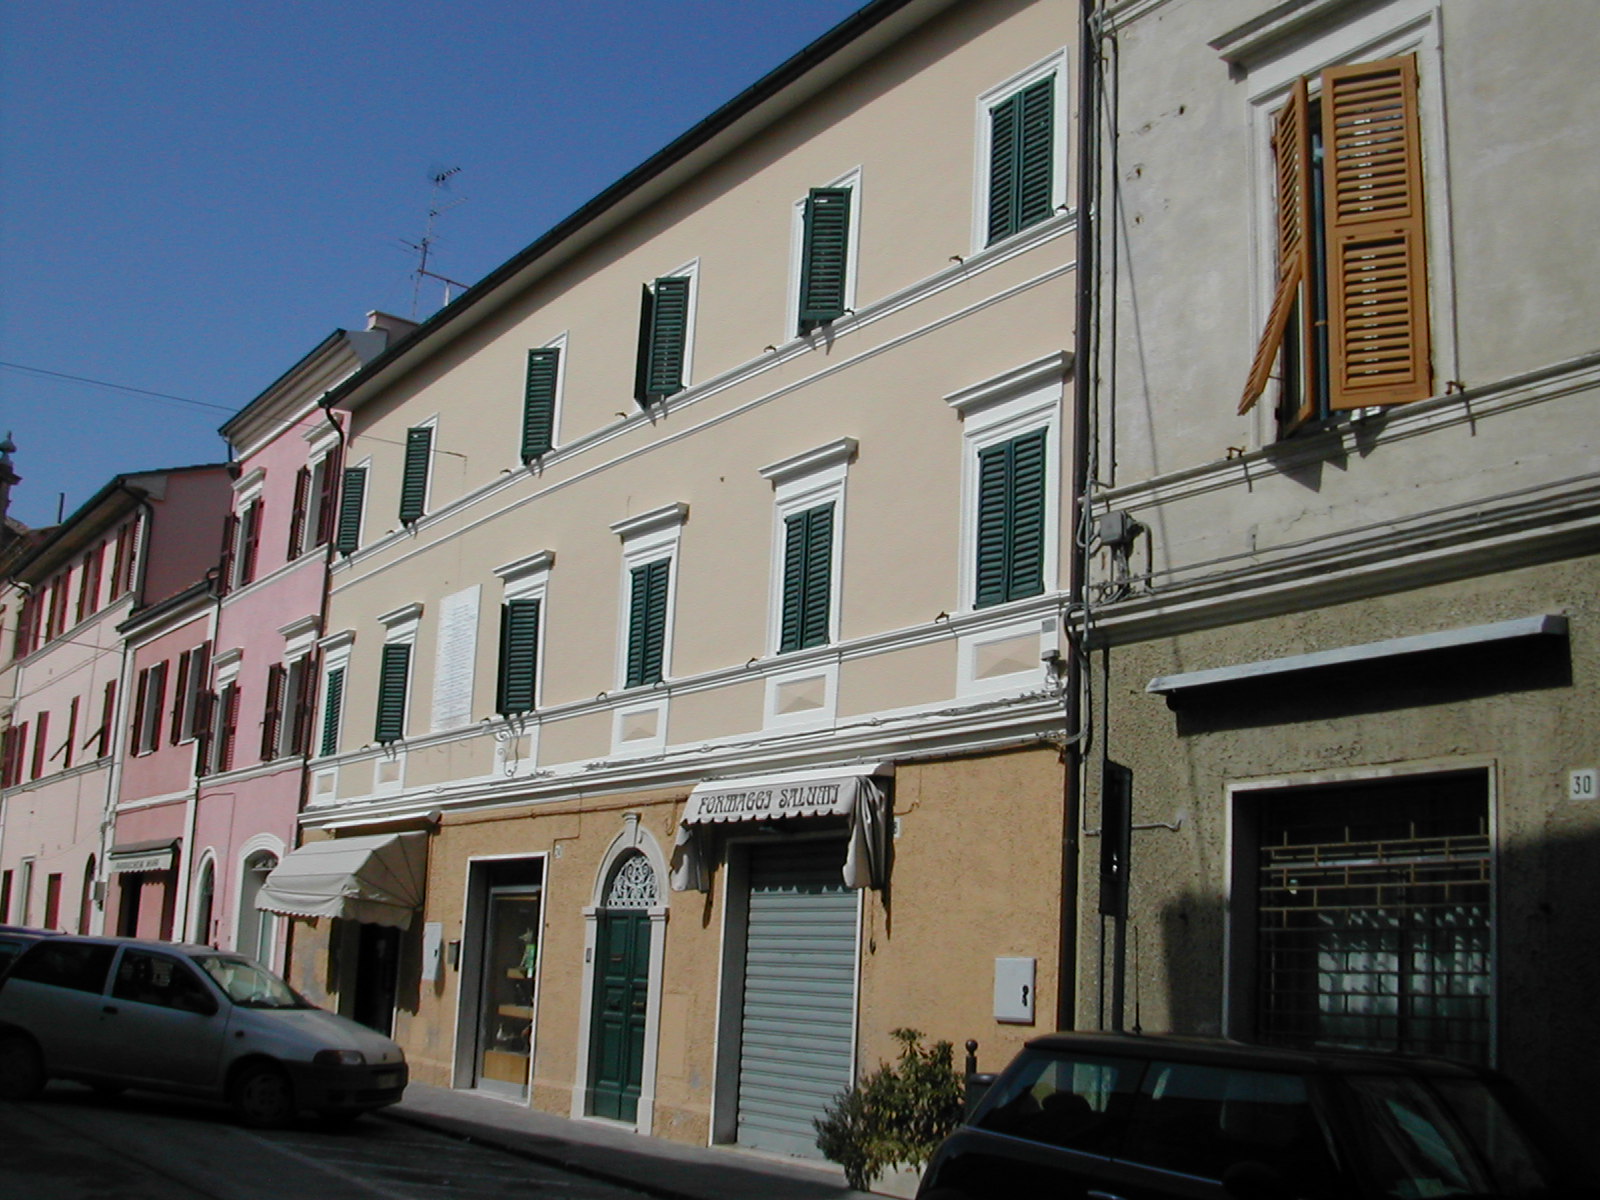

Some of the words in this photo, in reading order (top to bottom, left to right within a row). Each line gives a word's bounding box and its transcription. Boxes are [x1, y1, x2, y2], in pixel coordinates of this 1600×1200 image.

[1573, 775, 1591, 794] 30
[698, 791, 773, 814] FORMAGGI
[778, 784, 841, 809] SALUMI
